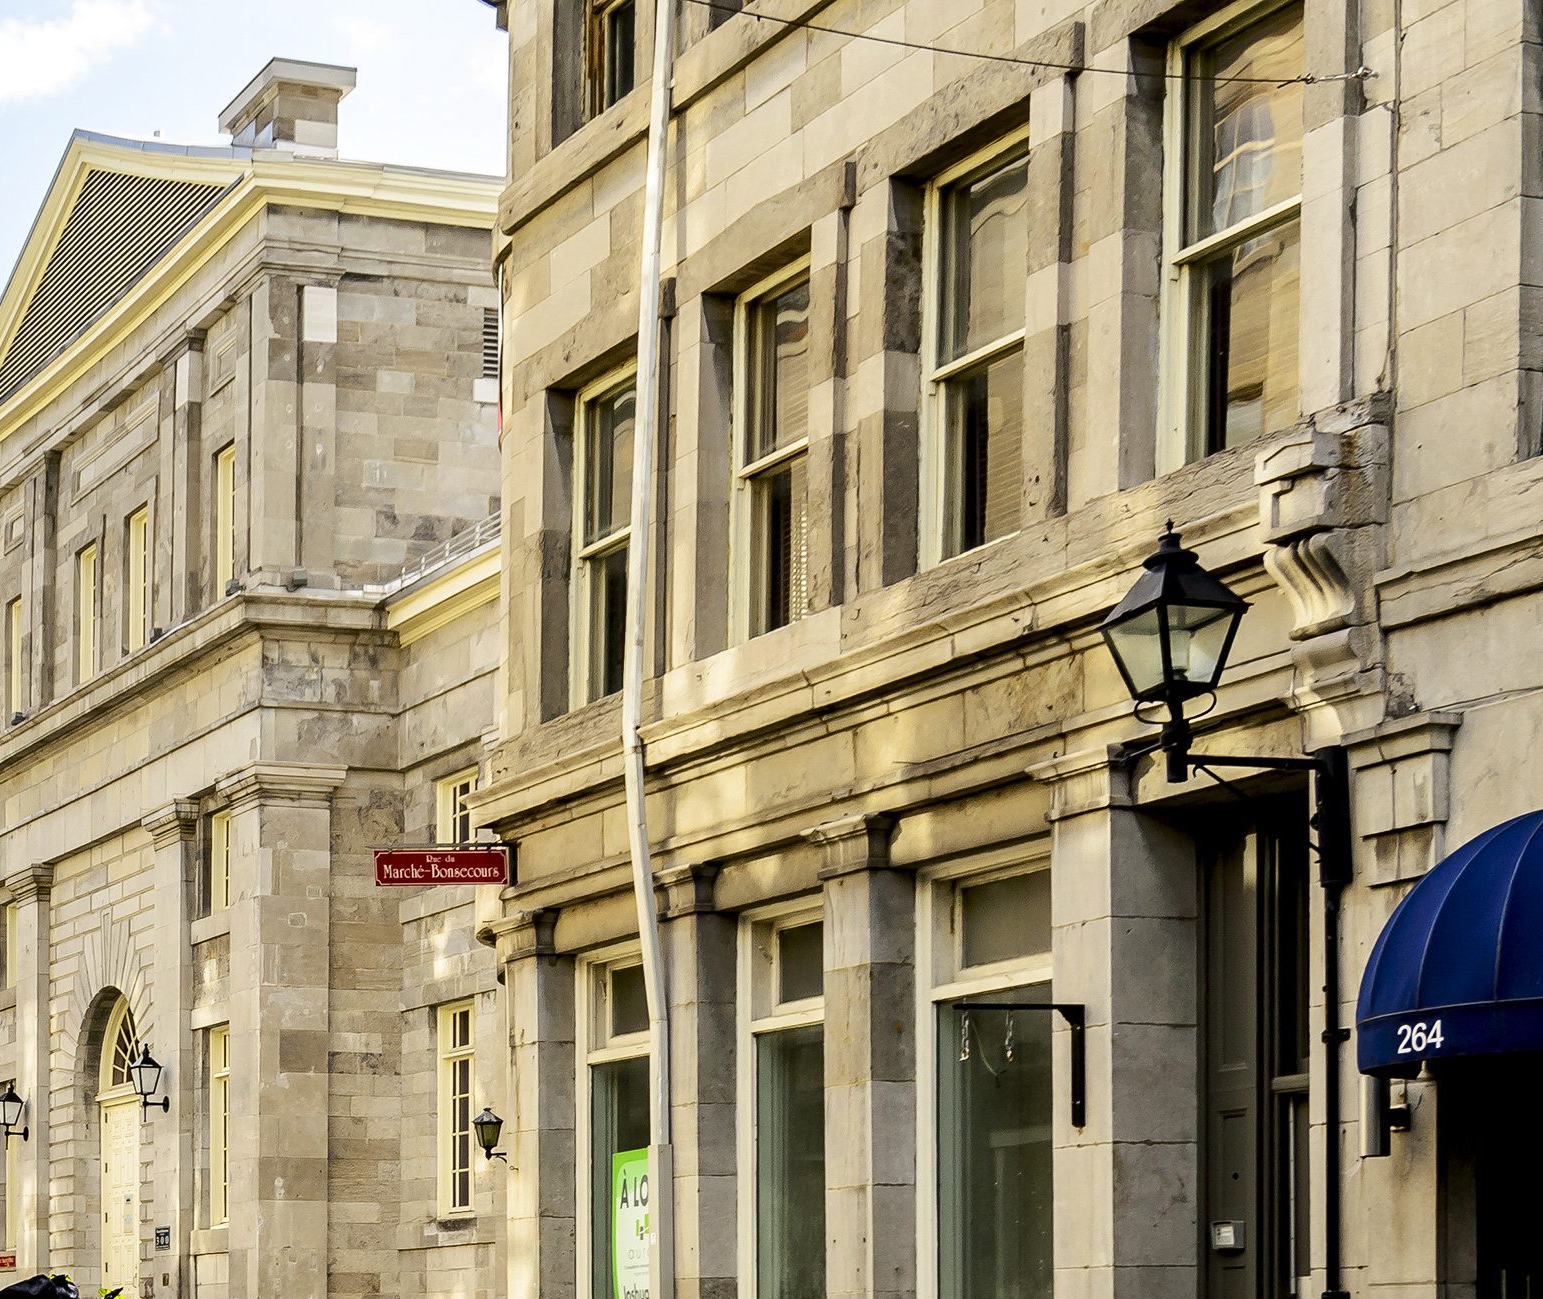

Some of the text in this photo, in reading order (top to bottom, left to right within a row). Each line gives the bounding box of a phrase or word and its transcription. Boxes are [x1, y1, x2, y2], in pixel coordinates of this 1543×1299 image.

[383, 863, 499, 879] Marché-Bonsecours
[426, 854, 455, 863] Rue du
[1397, 1019, 1444, 1054] 264
[619, 1168, 629, 1209] À
